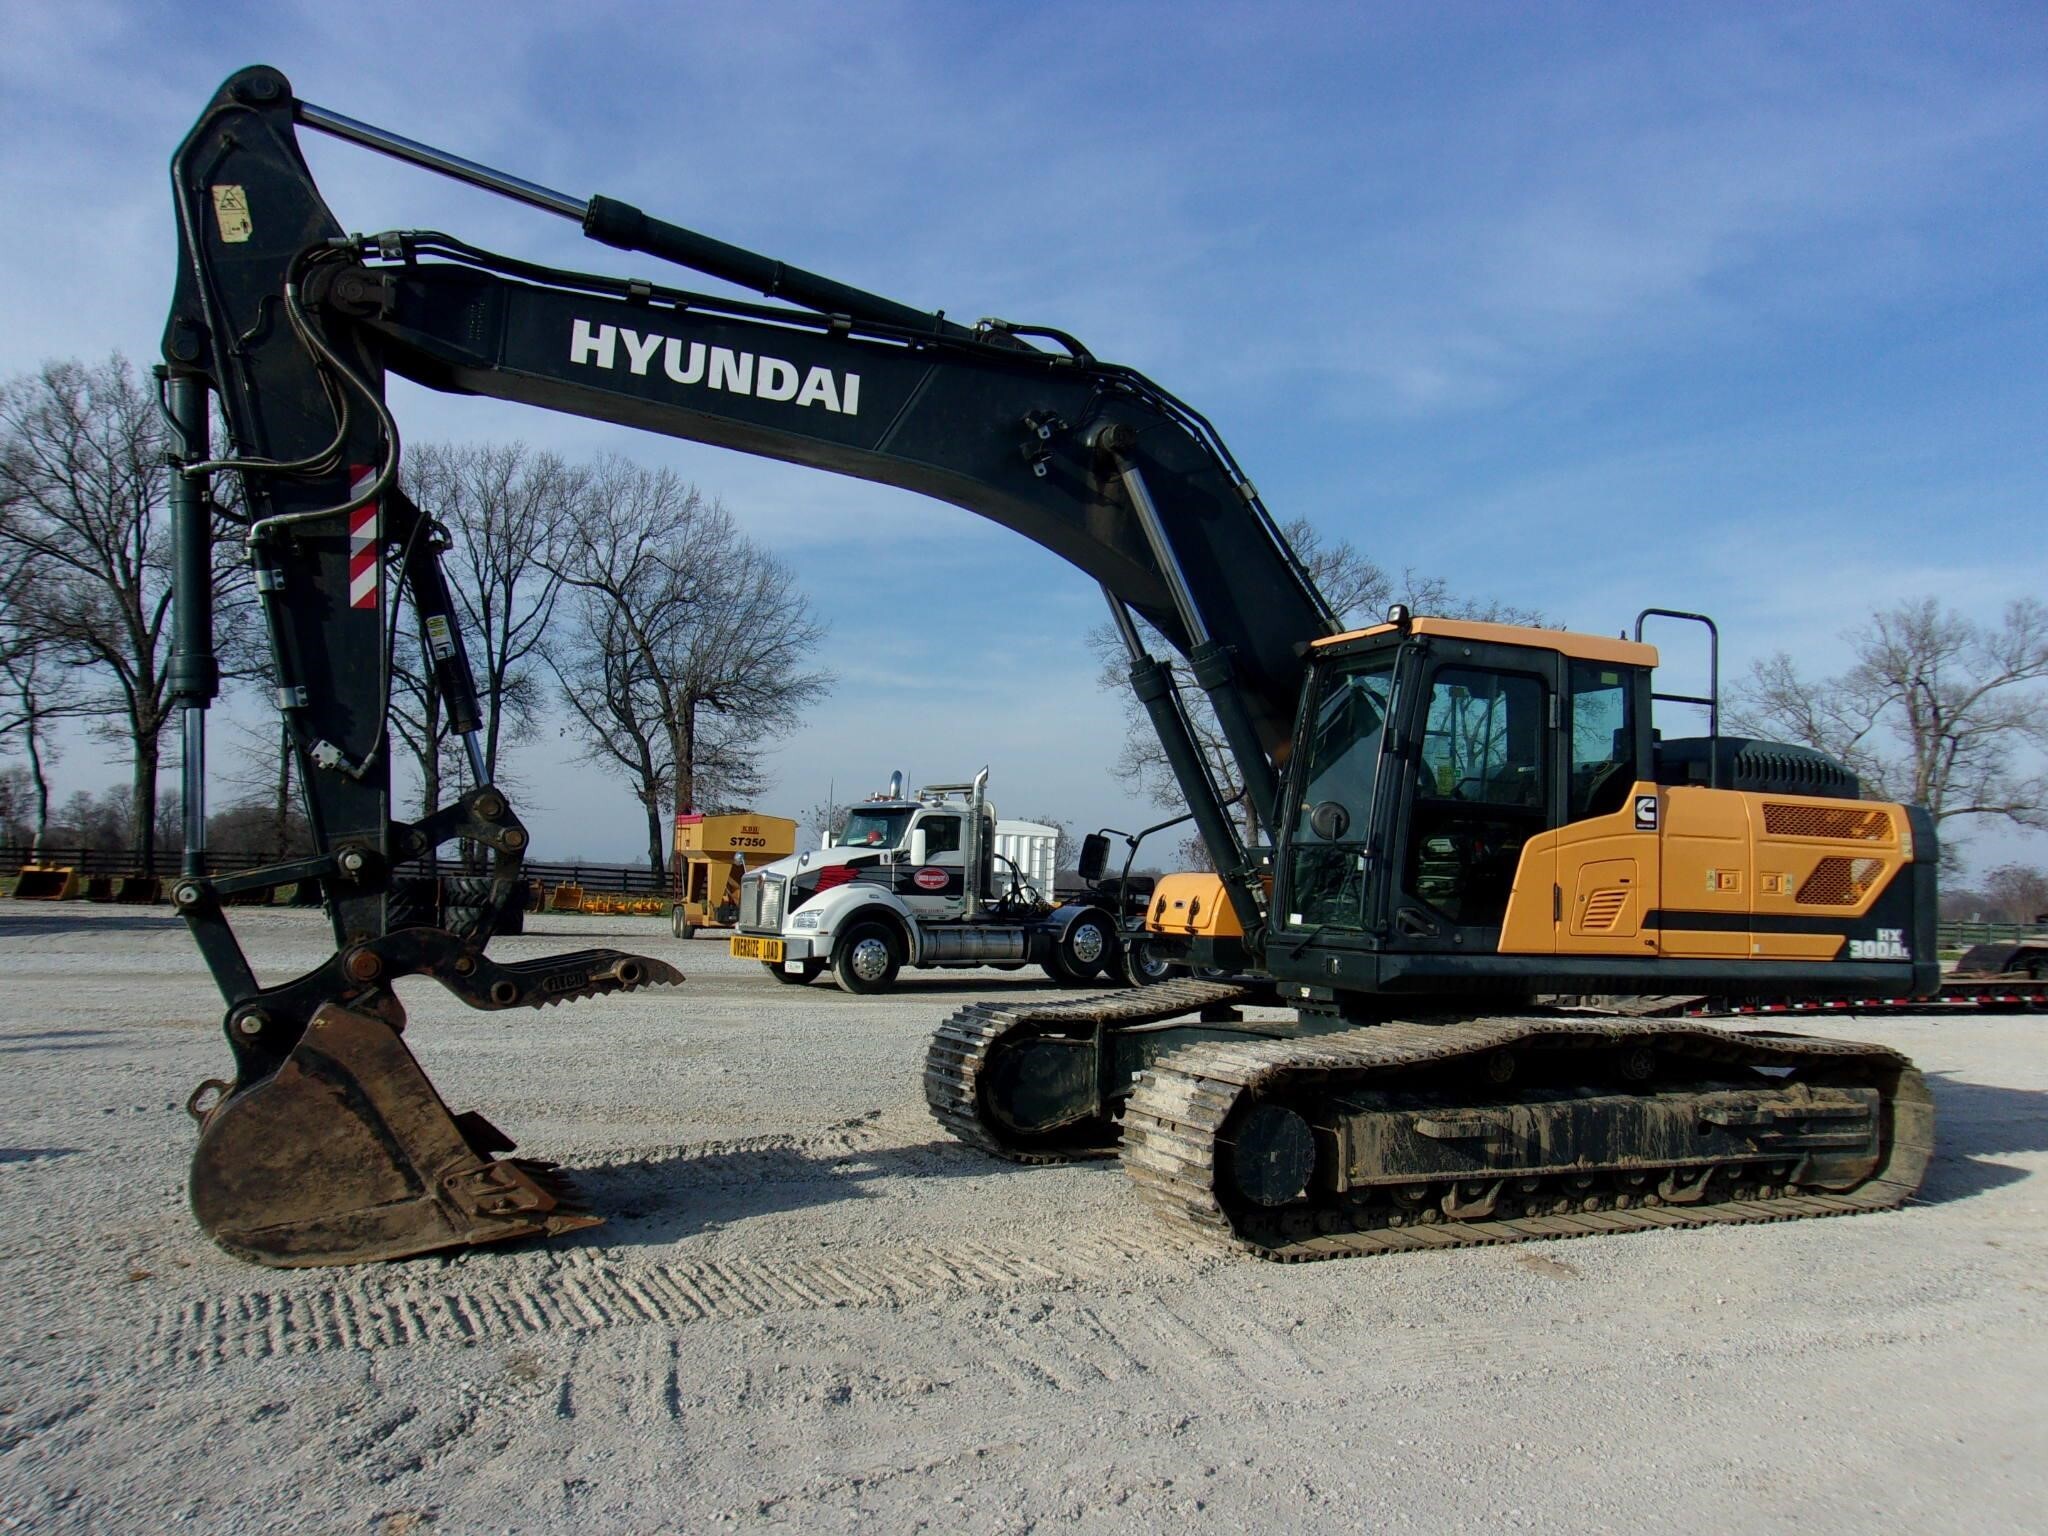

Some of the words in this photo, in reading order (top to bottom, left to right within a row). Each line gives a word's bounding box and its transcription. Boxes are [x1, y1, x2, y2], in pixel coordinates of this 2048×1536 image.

[570, 318, 860, 416] HYUNDAI
[730, 837, 766, 847] ST350
[1876, 928, 1903, 941] HX
[733, 937, 759, 958] OVERSIZE
[763, 940, 779, 960] LOAD
